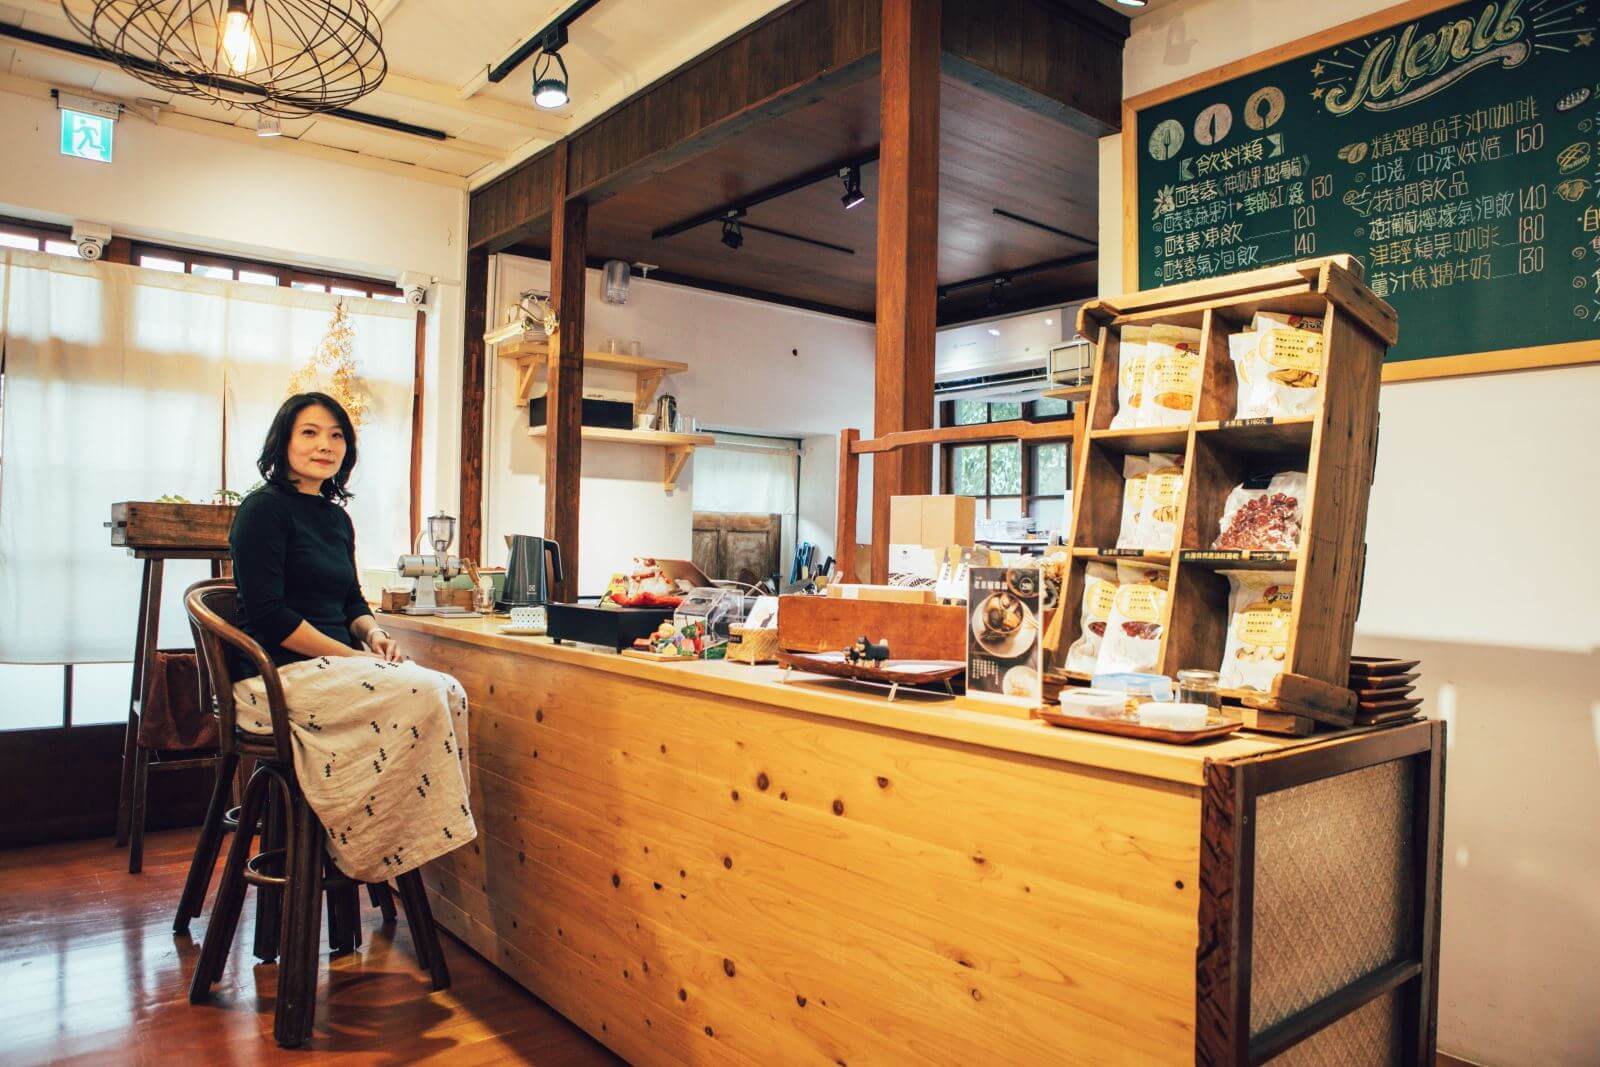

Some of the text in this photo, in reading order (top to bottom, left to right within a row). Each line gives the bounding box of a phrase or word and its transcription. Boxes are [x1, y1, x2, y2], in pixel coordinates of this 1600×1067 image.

[1325, 0, 1525, 116] Menu
[1371, 96, 1540, 160] 精選單品手沖咖啡
[1516, 123, 1544, 154] 150
[1195, 137, 1265, 177] 飲料類
[1311, 174, 1334, 201] 130
[1368, 183, 1547, 241] 樹葡萄檸檬氣泡飲 140
[1372, 170, 1470, 212] 特調飲品
[1164, 205, 1316, 257] 酵素凍飲 120
[1164, 232, 1316, 282] 酵素氣泡飲 140
[1369, 213, 1544, 268] 津輕蘋果咖啡 180
[1371, 245, 1545, 298] 薑汁焦糖牛奶 130
